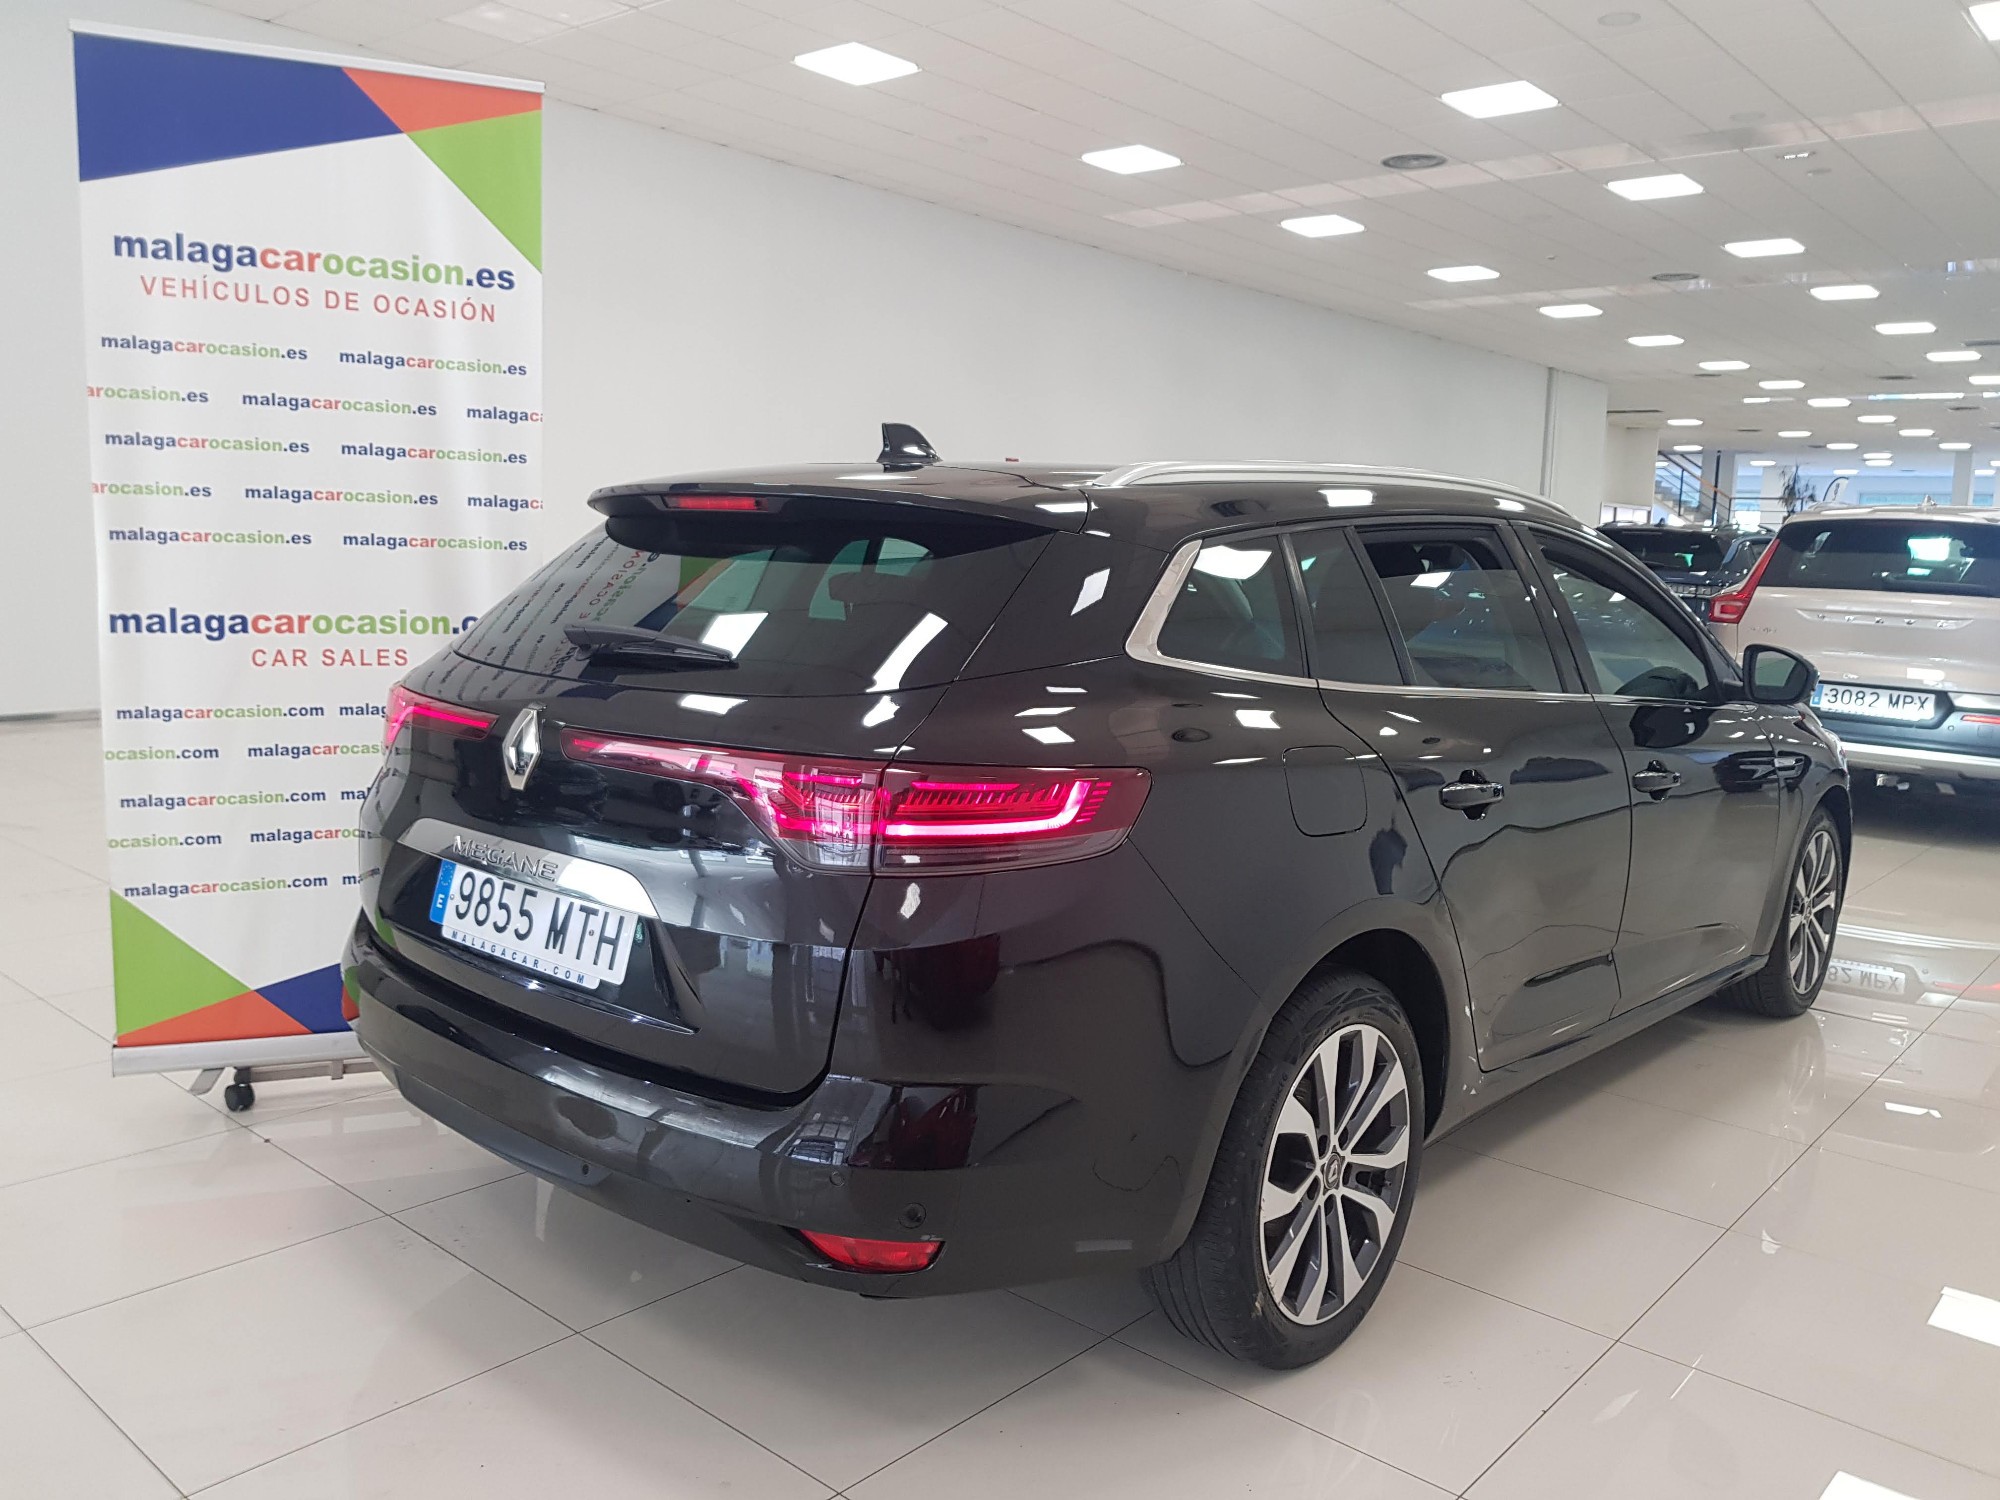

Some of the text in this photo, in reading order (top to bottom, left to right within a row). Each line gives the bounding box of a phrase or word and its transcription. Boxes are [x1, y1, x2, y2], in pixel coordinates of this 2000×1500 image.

[114, 233, 515, 290] malagacarocasion.es
[140, 275, 494, 322] VEHÍCULOS DE OCASIÓN
[101, 335, 307, 360] malagacarocasion.es
[340, 351, 527, 375] malagacarocasion.es
[242, 393, 437, 416] malagacarocasion.es
[105, 432, 309, 453] malagacarocasion.es
[341, 443, 527, 464] malagacarocasion.es
[245, 486, 438, 505] malagacarocasion.es
[109, 527, 312, 545] malagacarocasion.es
[343, 533, 527, 551] malagacarocasion.es
[108, 607, 479, 641] malagacarocasion.c
[252, 649, 408, 667] CAR SALES
[1827, 687, 1930, 712] 3082 MPX
[117, 705, 324, 722] malagacarocasion.com
[105, 746, 219, 760] ocasion.com
[248, 741, 383, 759] malagacarocas
[120, 791, 326, 810] malagacarocasion.com
[107, 834, 222, 848] ocasion.com
[124, 877, 328, 898] malagacarocasion.com
[435, 893, 446, 909] E
[455, 871, 625, 971] 9855 MTH
[451, 930, 586, 985] MALAGACAR.COM
